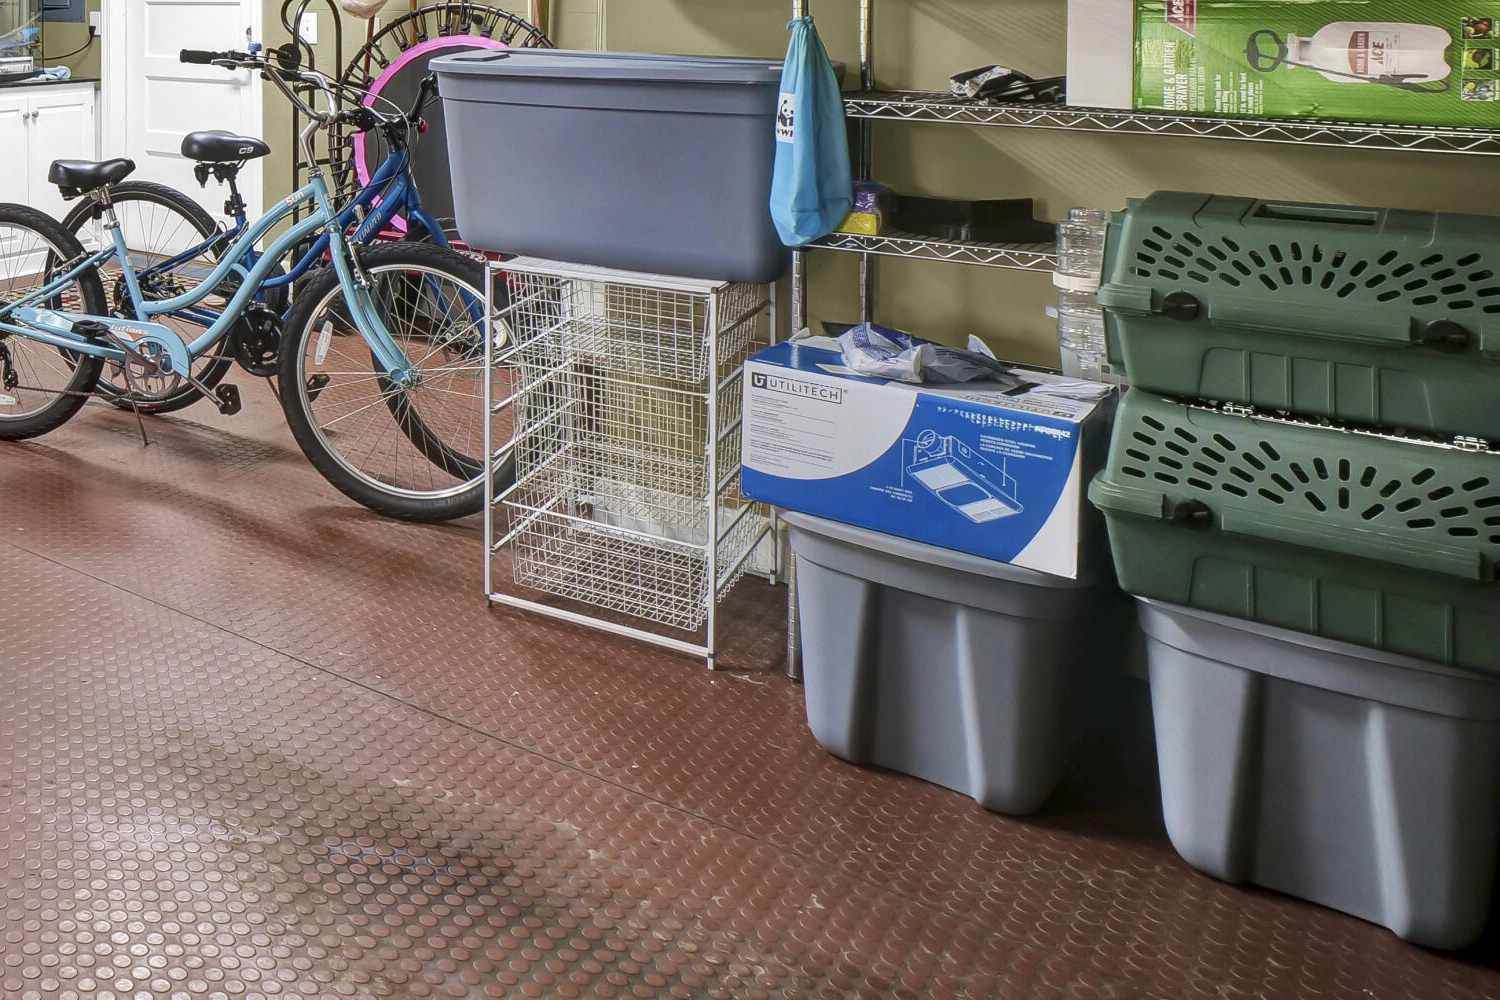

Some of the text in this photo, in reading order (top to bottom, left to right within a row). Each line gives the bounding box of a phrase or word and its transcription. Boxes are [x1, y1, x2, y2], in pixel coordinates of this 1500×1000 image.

[1171, 0, 1185, 22] ACE
[1371, 41, 1384, 65] ACE
[1163, 41, 1176, 111] HOME & GARDEN
[1175, 73, 1188, 111] SPRAYER
[238, 146, 254, 155] C9
[286, 191, 306, 207] Sun
[109, 323, 149, 335] lutions
[769, 378, 839, 401] UTILITECH
